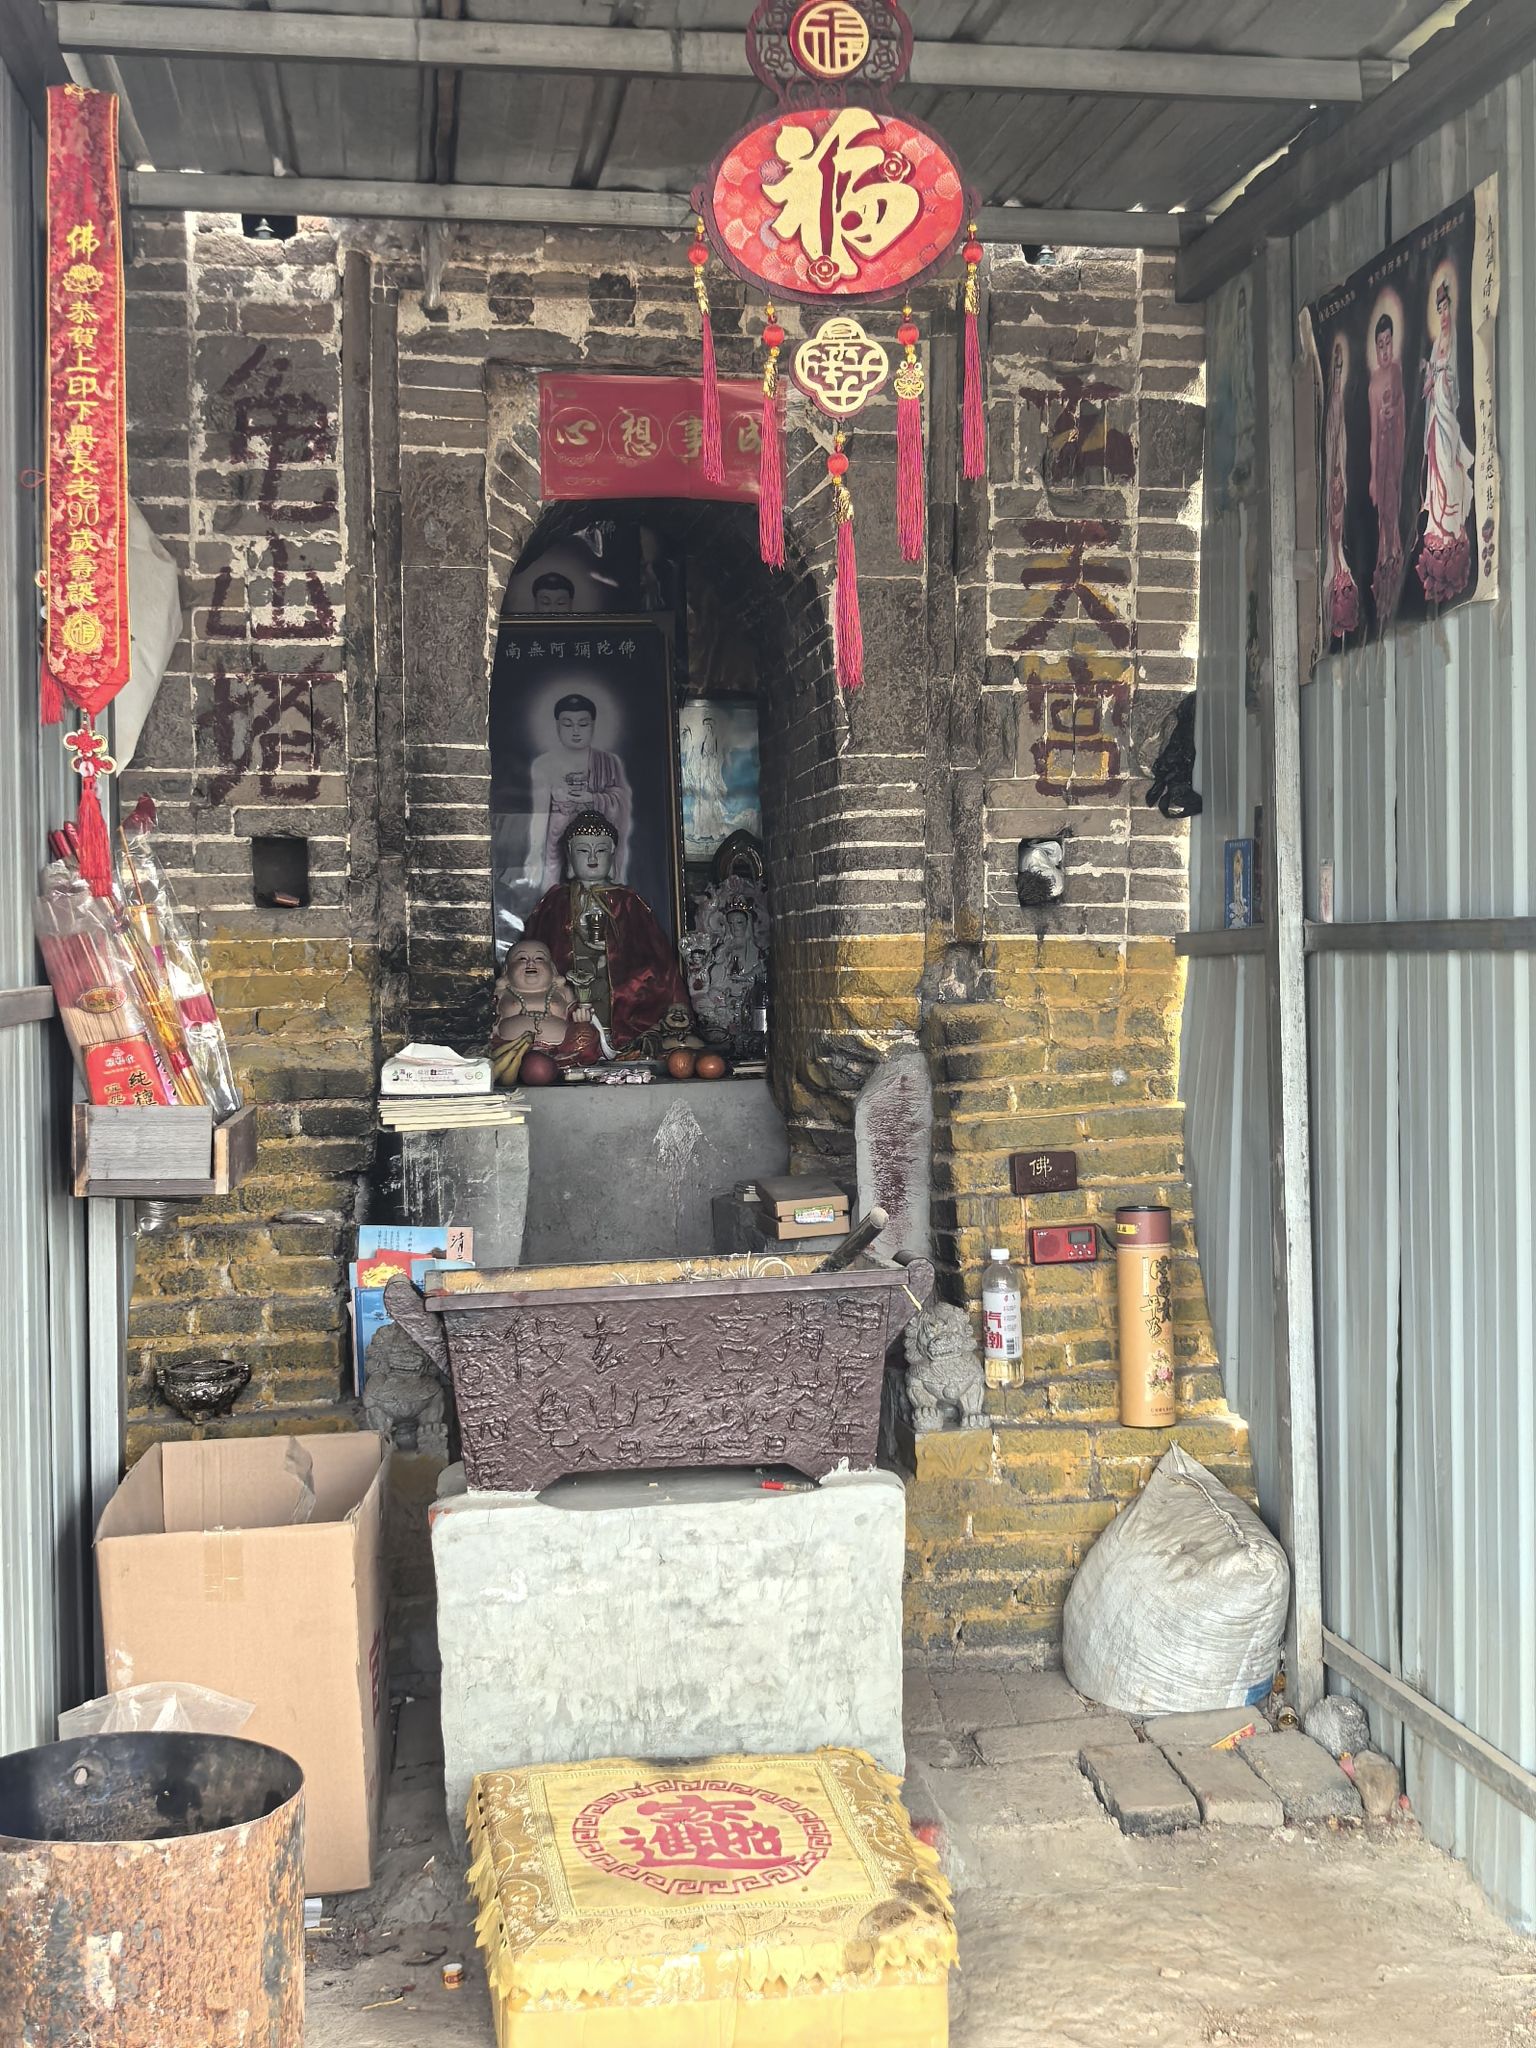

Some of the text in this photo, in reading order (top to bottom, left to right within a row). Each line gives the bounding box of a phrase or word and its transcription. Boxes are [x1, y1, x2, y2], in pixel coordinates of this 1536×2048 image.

[799, 2, 869, 74] 福
[762, 107, 919, 278] 福
[66, 220, 100, 262] 佛
[1029, 1155, 1053, 1178] 佛
